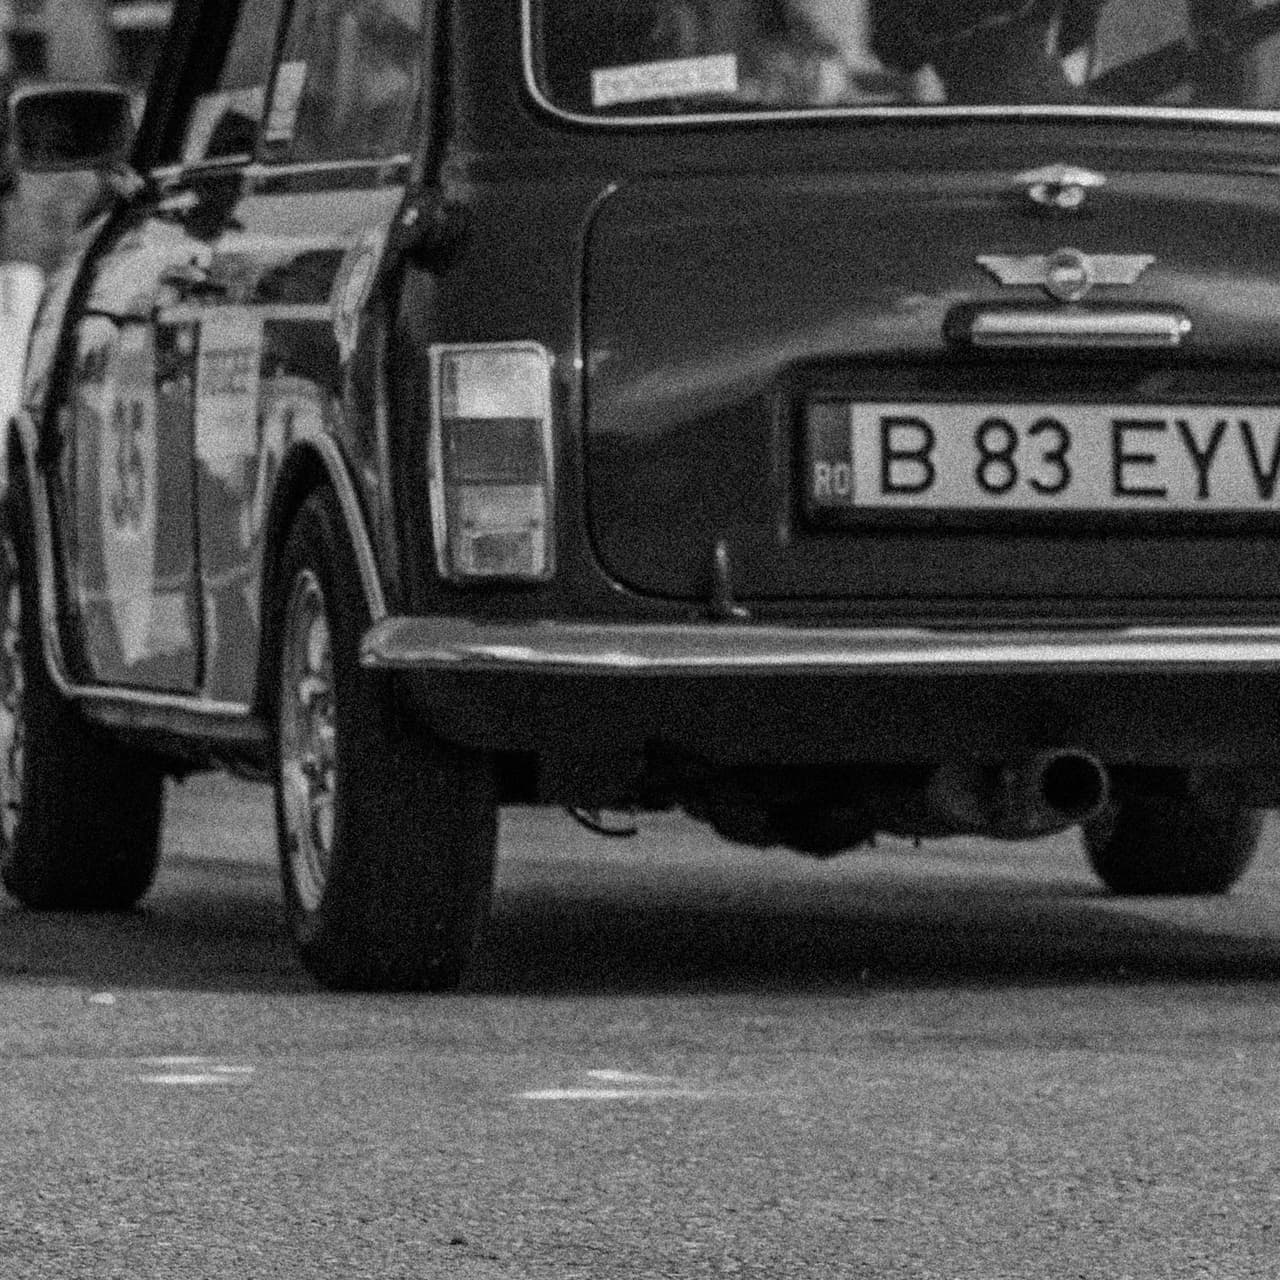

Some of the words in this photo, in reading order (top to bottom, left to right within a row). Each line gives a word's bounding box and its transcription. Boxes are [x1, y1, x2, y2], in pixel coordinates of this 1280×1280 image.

[813, 461, 850, 495] RO
[879, 415, 937, 496] B
[973, 416, 1073, 497] 83
